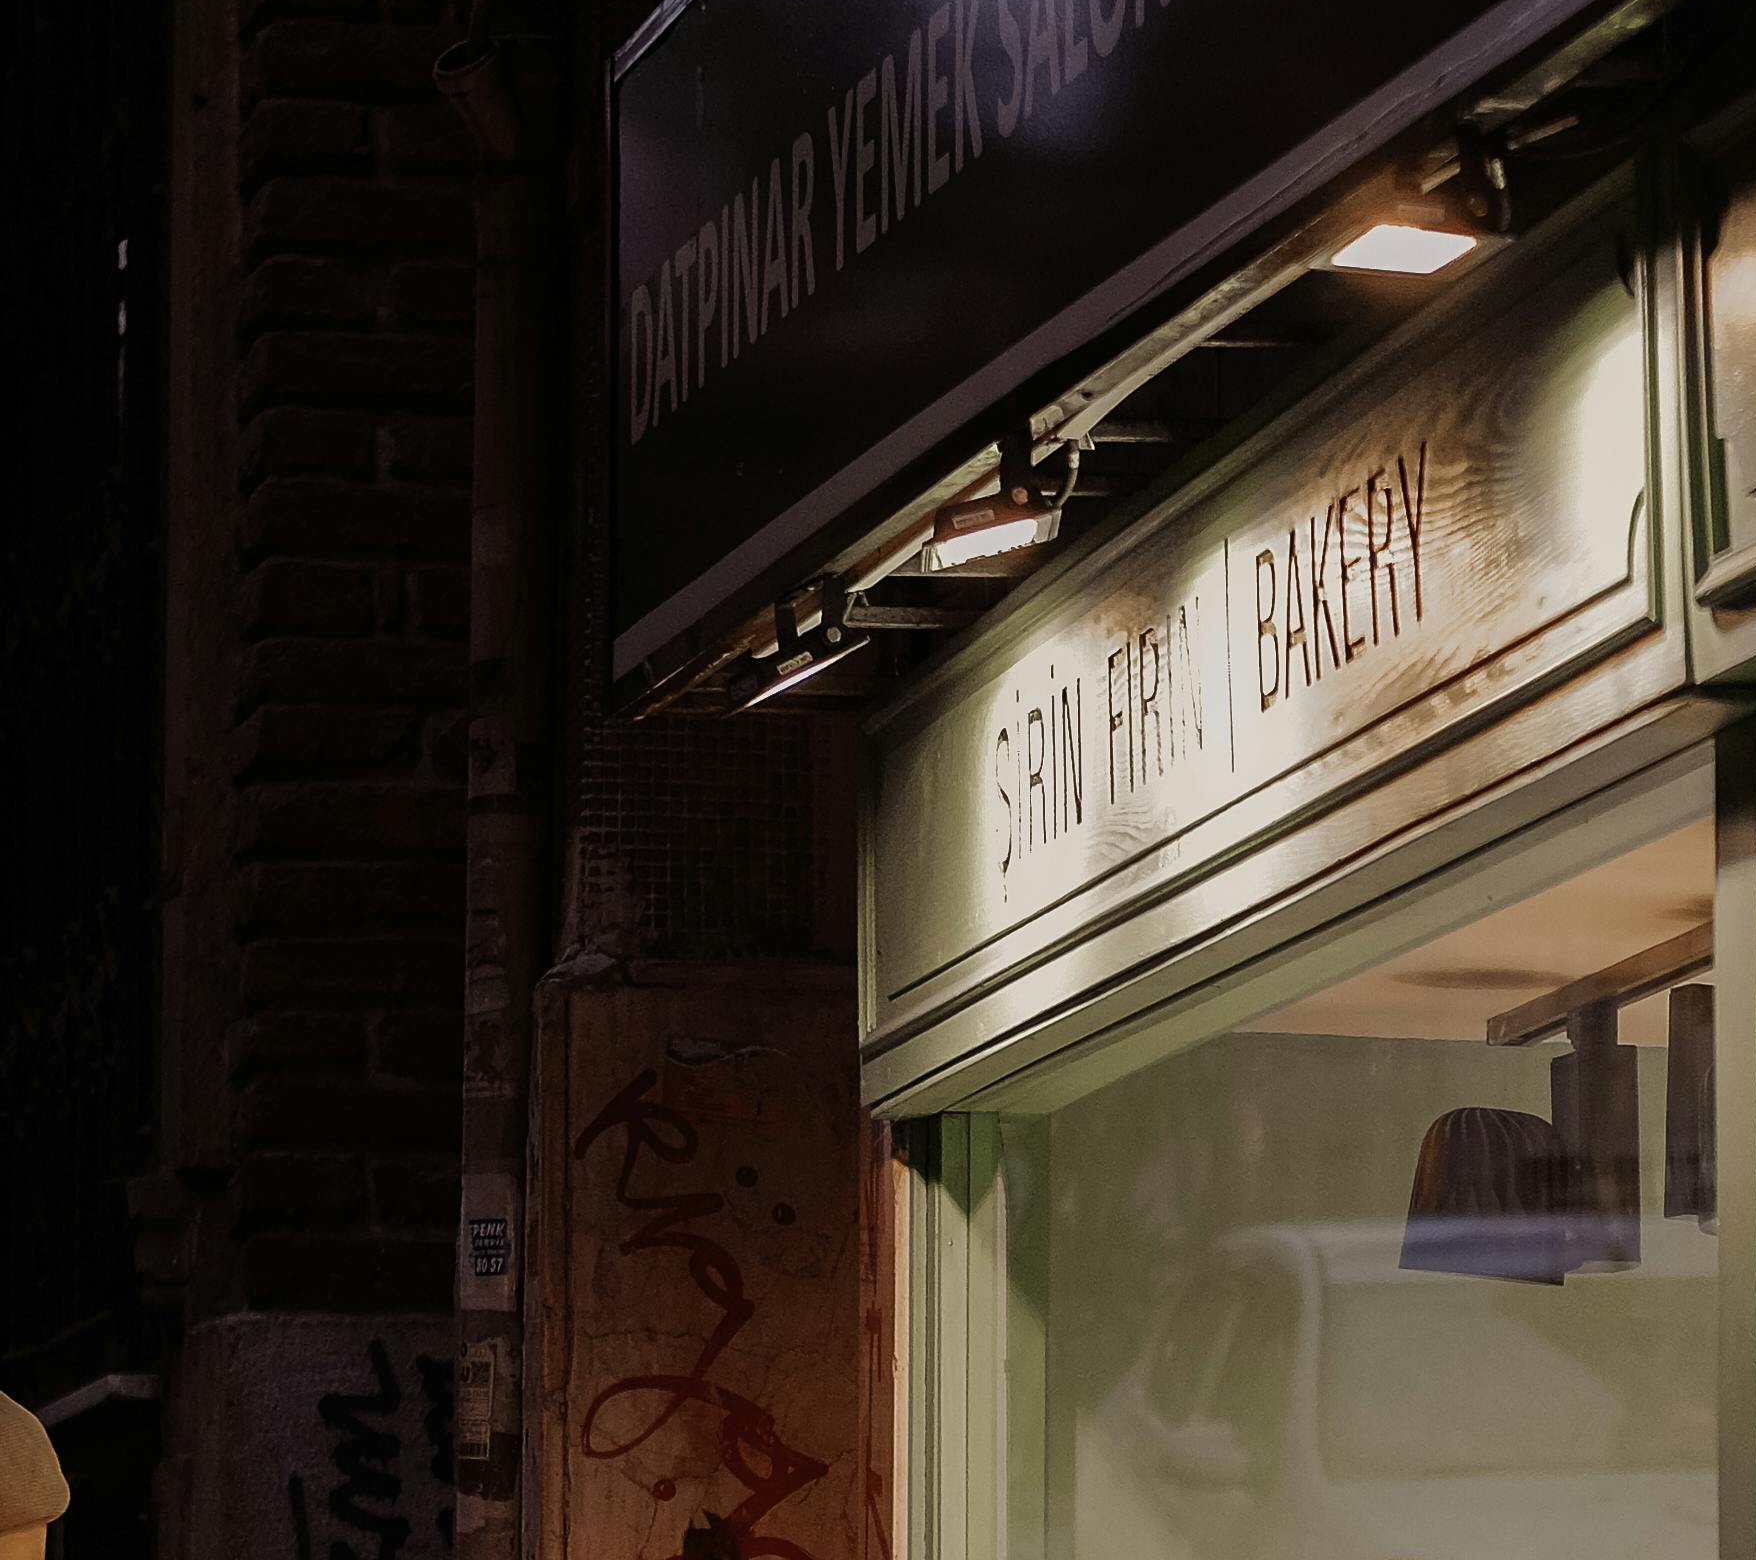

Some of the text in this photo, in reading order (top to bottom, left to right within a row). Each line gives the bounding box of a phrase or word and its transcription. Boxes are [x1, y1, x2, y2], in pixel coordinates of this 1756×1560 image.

[630, 130, 815, 447] DATPINAR
[1108, 595, 1204, 805] FIRIN
[1255, 440, 1428, 713] BAKERY
